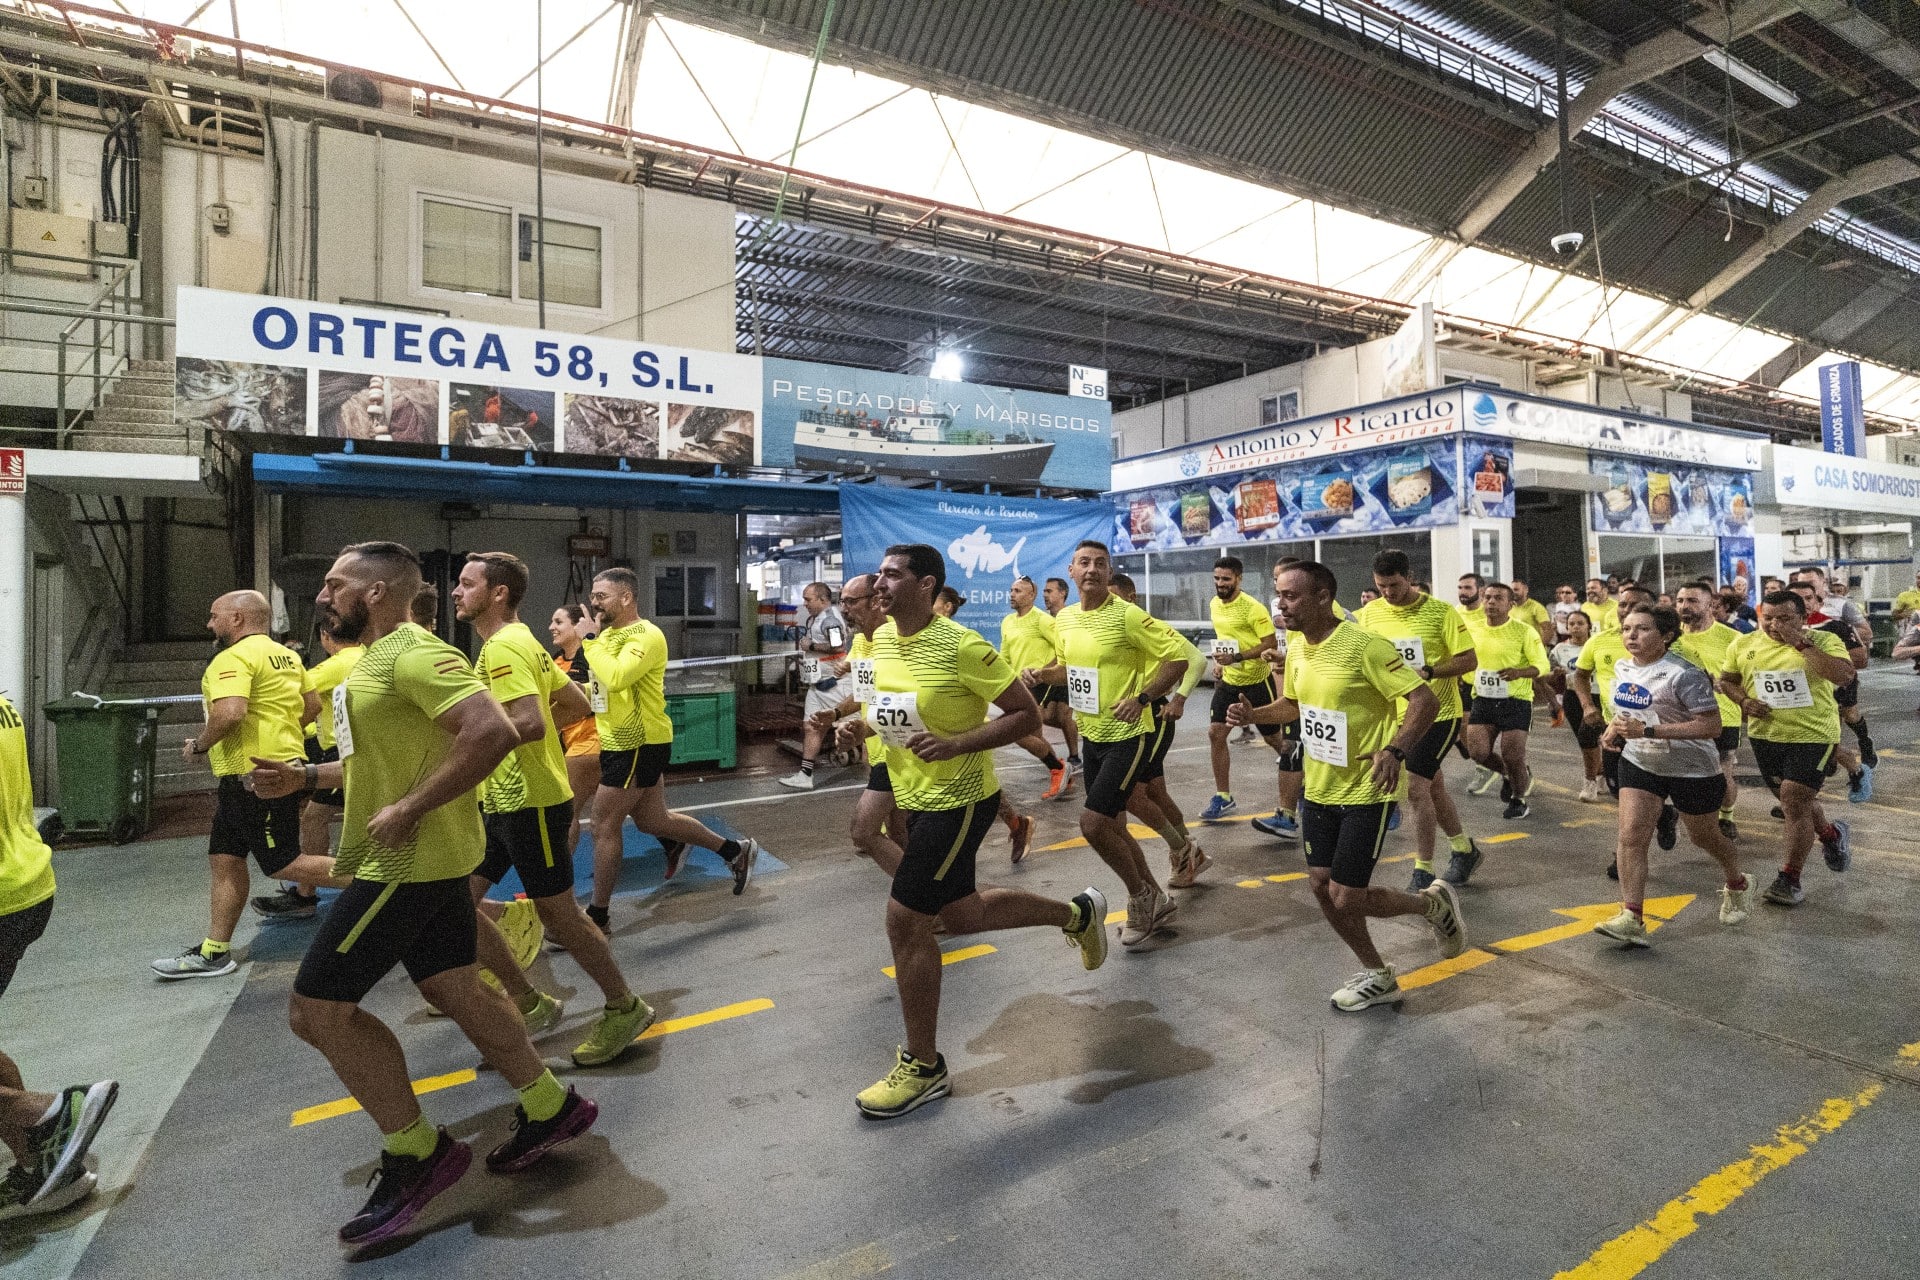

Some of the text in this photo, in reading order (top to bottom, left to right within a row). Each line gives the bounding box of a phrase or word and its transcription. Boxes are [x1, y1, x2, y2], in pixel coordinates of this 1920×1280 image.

[253, 307, 714, 394] ORTEGA 58, S.L.
[1082, 383, 1105, 397] 58
[772, 379, 1100, 433] PESCADOS Y MARISCOS
[1829, 365, 1845, 456] ESCADOS DE CRIANZA
[1208, 397, 1454, 462] Antonio y Ricardo
[1207, 420, 1454, 473] Alimentación de Calidad
[1814, 465, 1850, 490] CASA
[938, 501, 981, 516] Mercado
[984, 505, 996, 517] de
[268, 655, 296, 670] UME
[1069, 676, 1092, 694] 569
[1480, 675, 1501, 687] 561
[1764, 679, 1796, 693] 618
[876, 708, 913, 727] 572
[1304, 718, 1337, 743] 562
